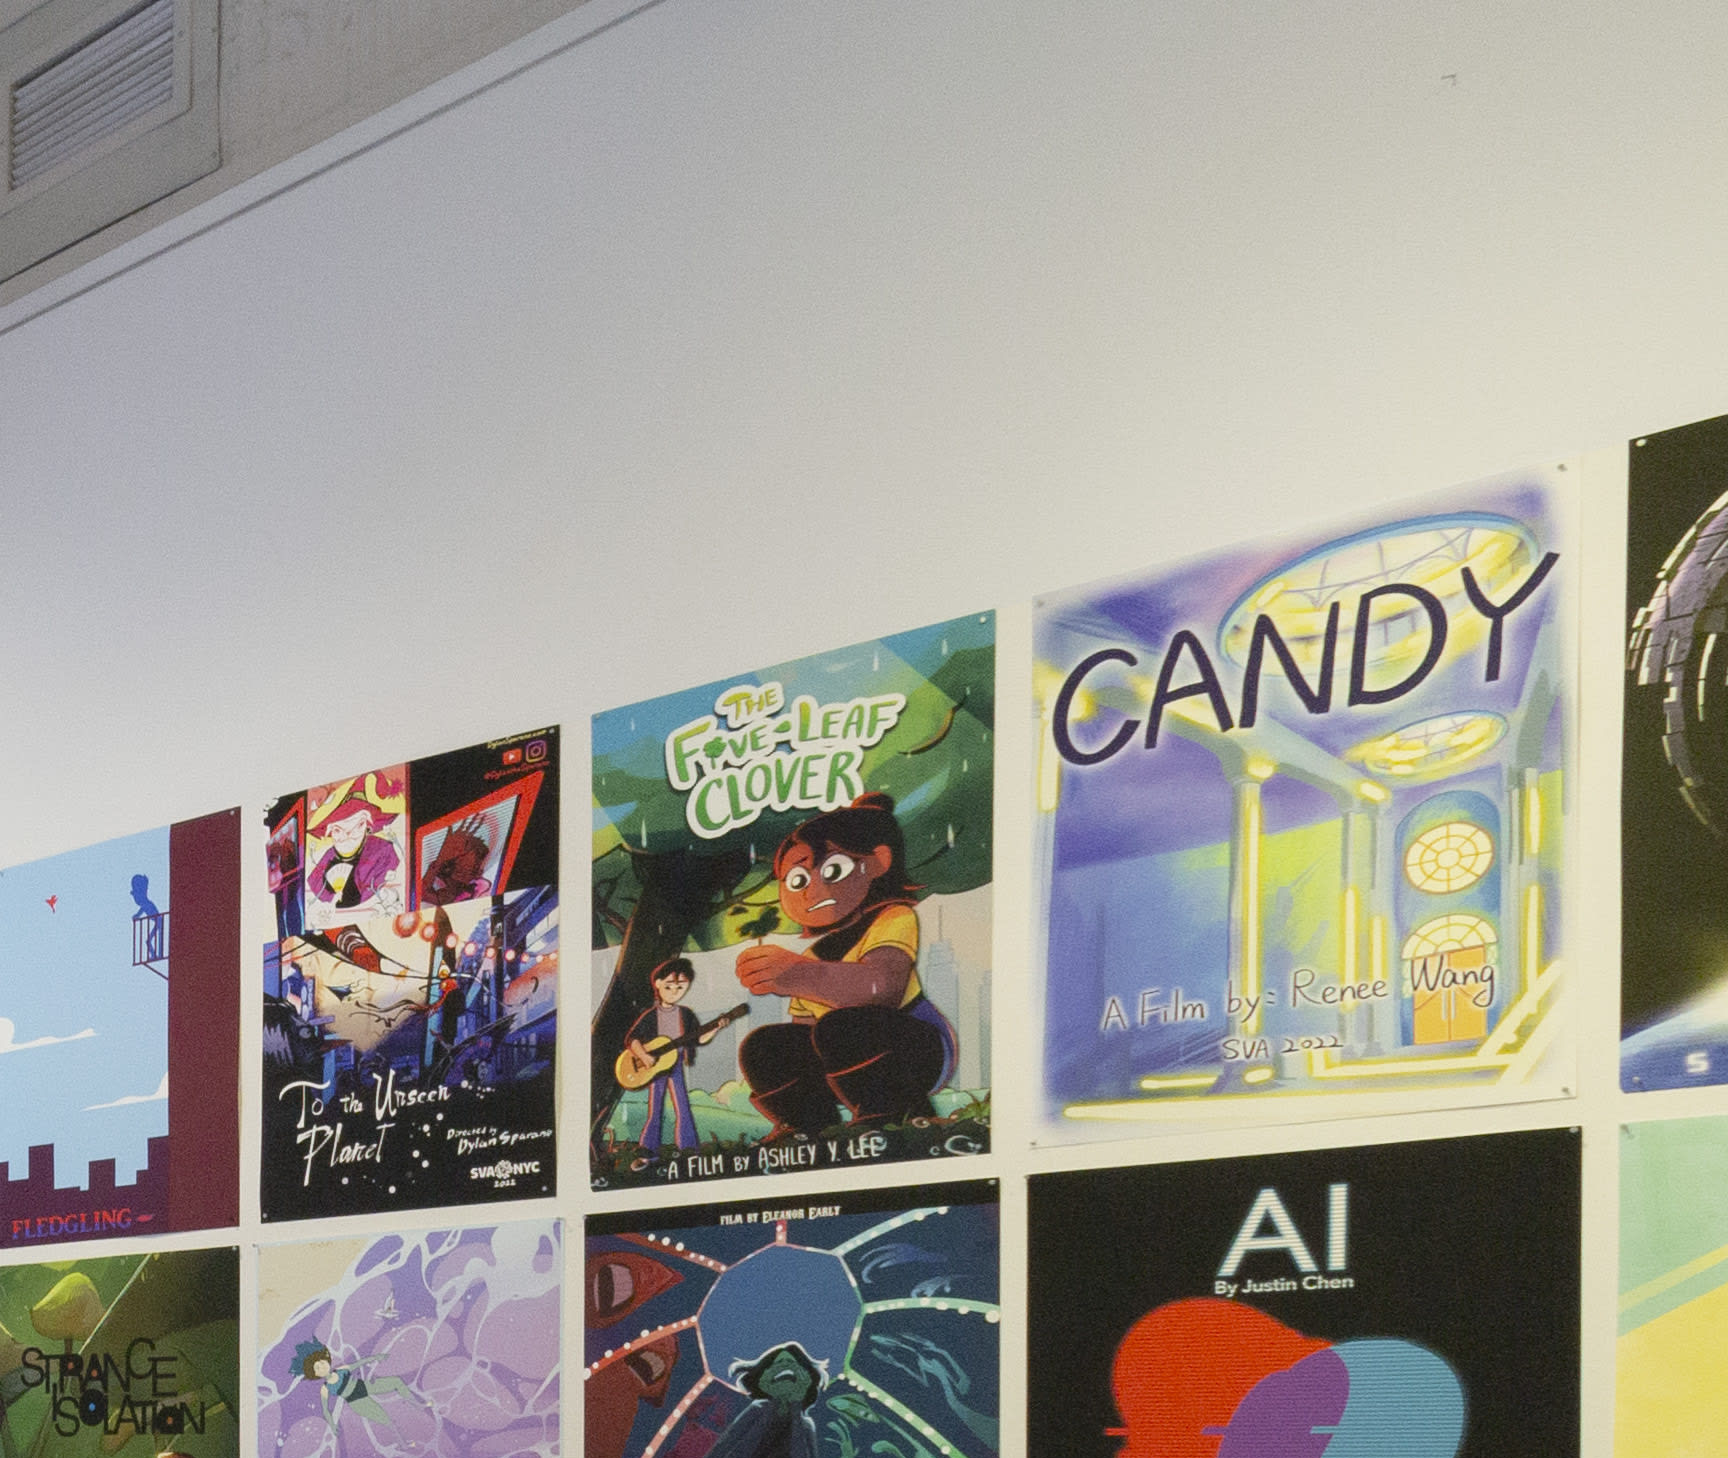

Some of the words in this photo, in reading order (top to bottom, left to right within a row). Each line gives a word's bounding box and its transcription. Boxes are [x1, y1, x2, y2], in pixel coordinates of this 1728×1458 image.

[1051, 552, 1559, 766] CANDY
[722, 688, 779, 717] THE
[693, 752, 860, 831] CLOVER
[1100, 998, 1128, 1031] A
[1140, 992, 1206, 1024] Film
[1292, 968, 1389, 1004] Renee
[1410, 952, 1496, 1008] Wang
[1222, 1038, 1270, 1061] SVA
[1282, 1035, 1344, 1054] 2022
[279, 1080, 332, 1129] To
[339, 1092, 364, 1113] the
[373, 1069, 451, 1121] Unseen
[447, 1126, 487, 1140] Directed
[457, 1136, 497, 1155] Dylan
[499, 1127, 553, 1144] Sparano
[470, 1165, 495, 1179] SVA
[512, 1160, 540, 1175] NYC
[667, 1160, 679, 1181] A
[687, 1154, 724, 1179] FILM
[734, 1152, 751, 1172] BY
[758, 1143, 816, 1168] ASHLEY
[848, 1137, 884, 1159] LEE
[12, 1208, 132, 1239] FLEDGLING
[719, 1213, 743, 1226] FILM
[1217, 1183, 1350, 1278] AI
[1213, 1279, 1239, 1296] By
[1241, 1277, 1298, 1293] Justin
[1302, 1273, 1355, 1290] Chen
[52, 1383, 206, 1437] ISOLATION
